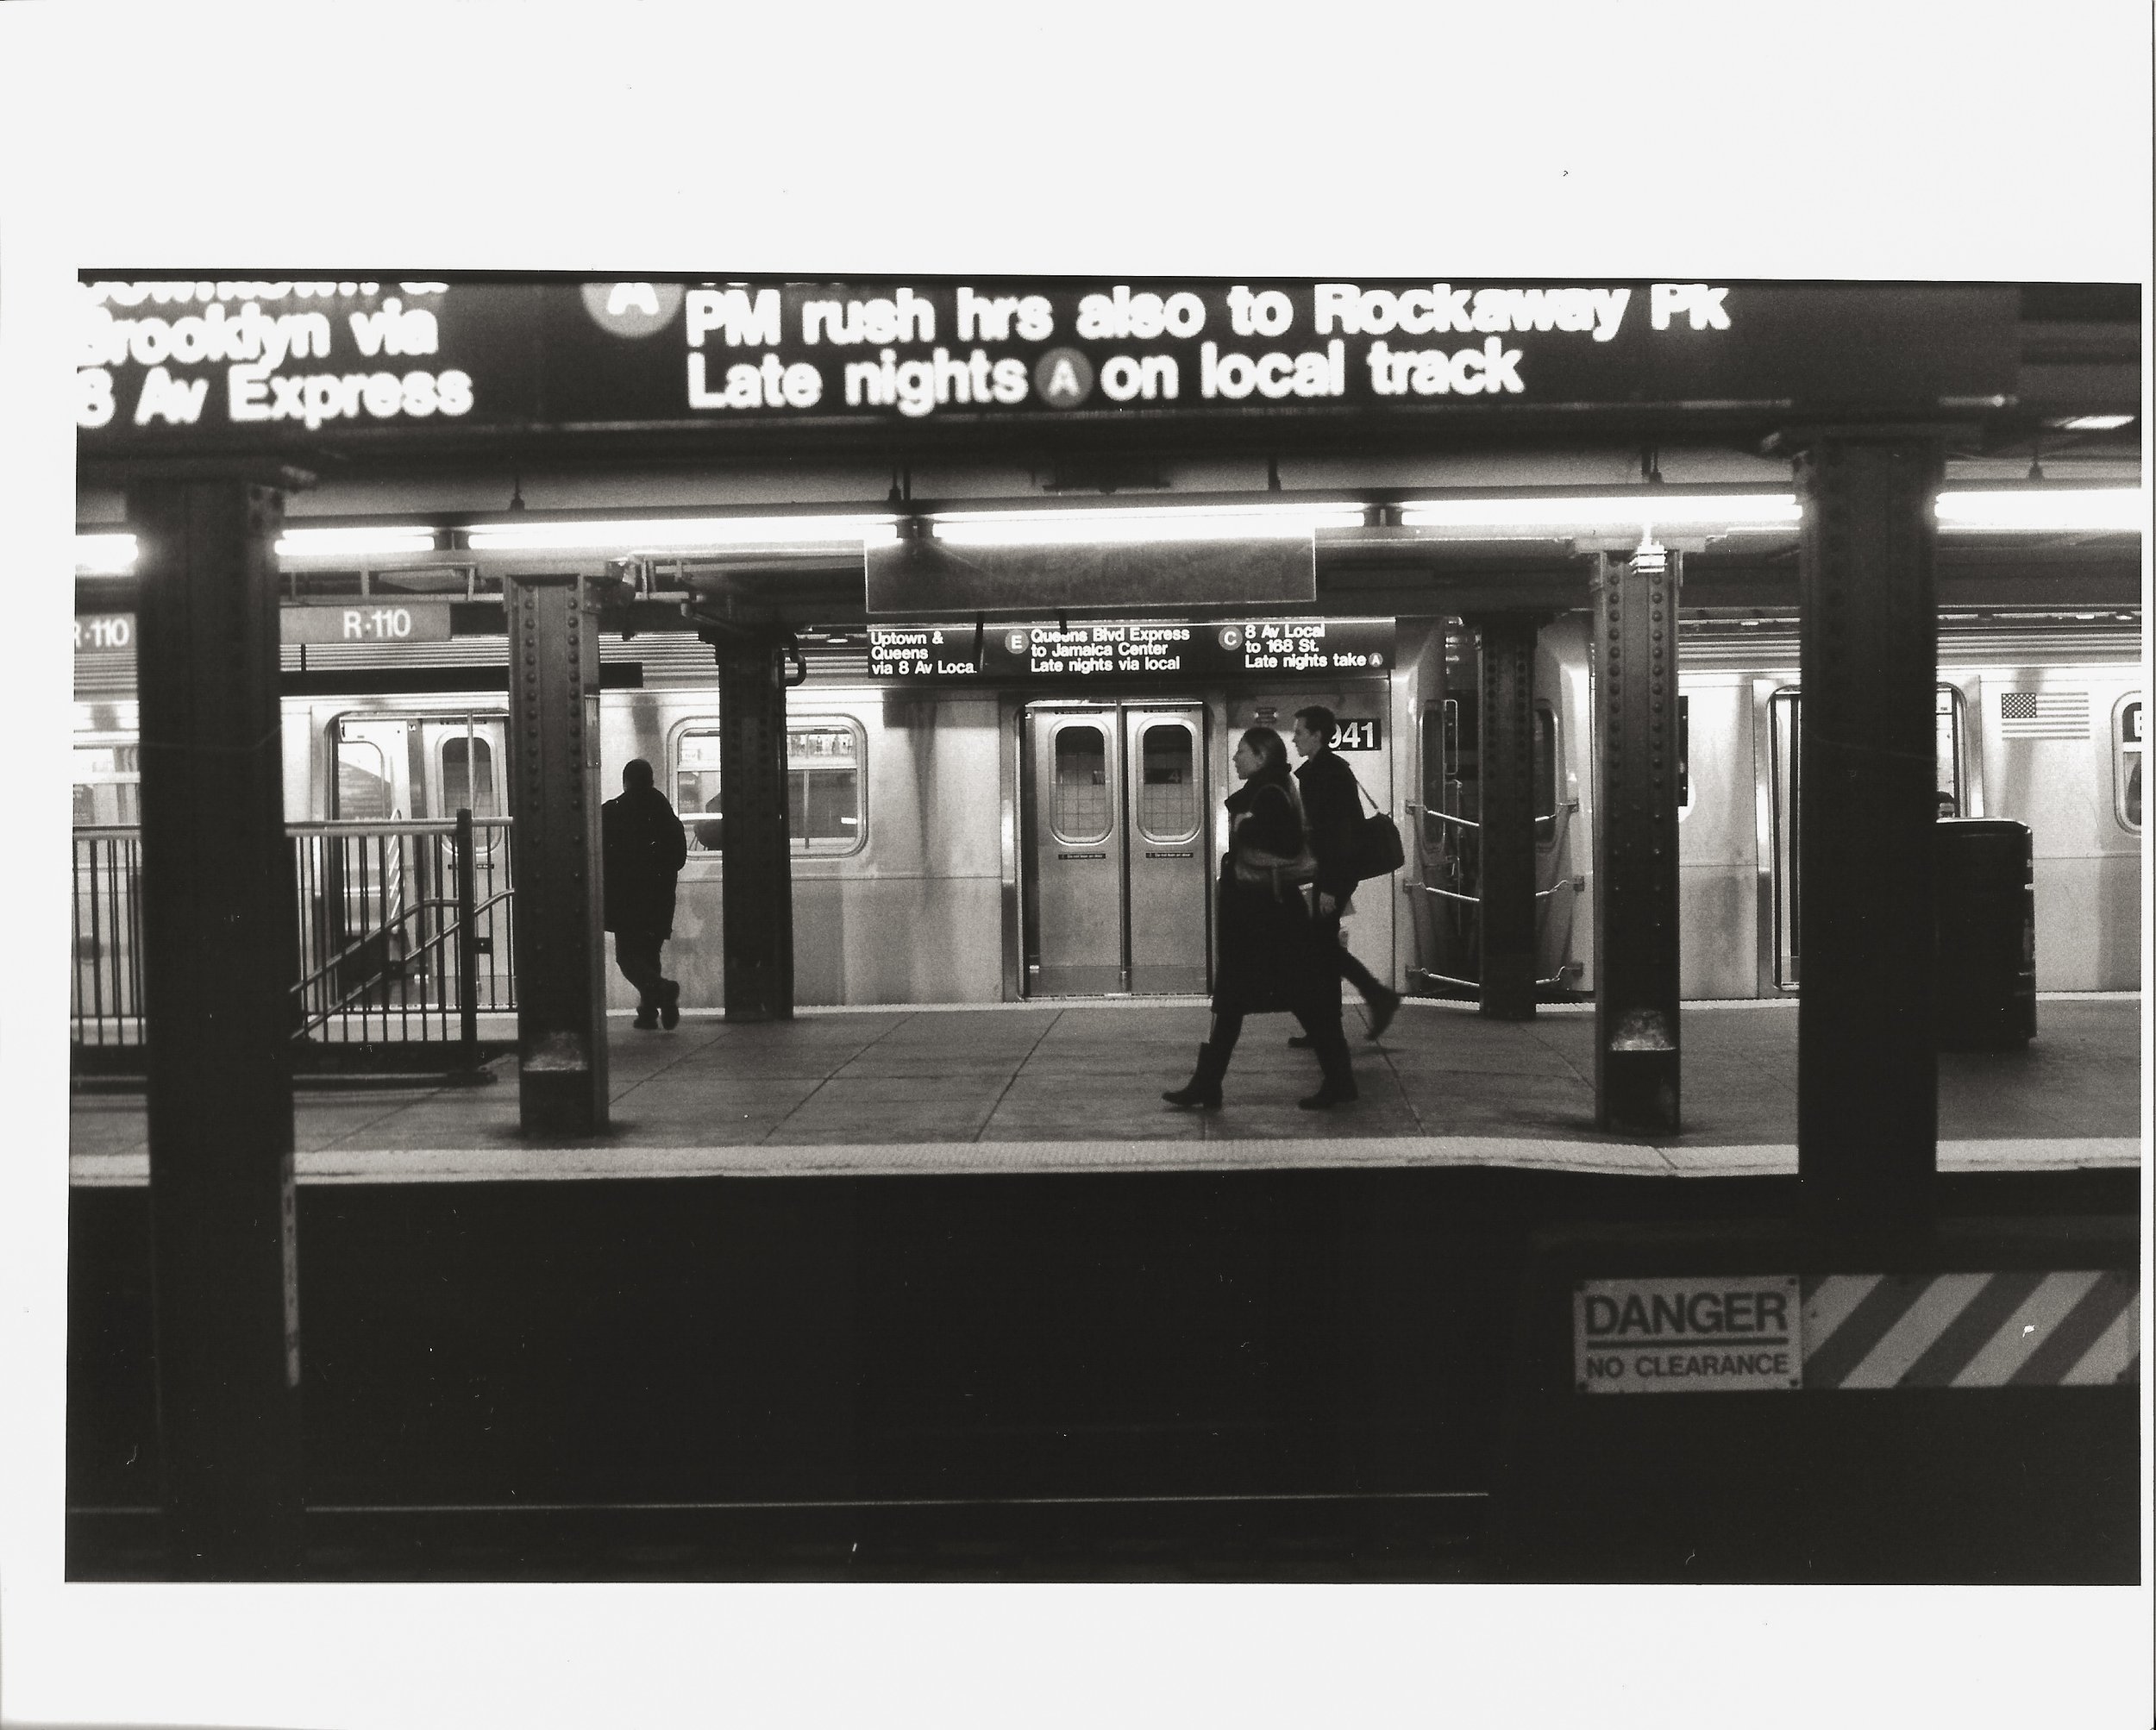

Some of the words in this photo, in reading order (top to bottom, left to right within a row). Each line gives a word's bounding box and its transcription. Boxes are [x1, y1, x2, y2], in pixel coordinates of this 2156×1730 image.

[686, 288, 781, 347] PM
[802, 286, 936, 346] rush
[957, 286, 1053, 342] hrs
[1076, 285, 1206, 340] also
[1226, 285, 1294, 337] to
[1314, 283, 1632, 342] Rockaway
[1651, 283, 1732, 331] Pk
[349, 297, 440, 356] via
[686, 351, 824, 409] Late
[845, 348, 1029, 417] nights
[1046, 355, 1081, 398] A
[1100, 354, 1179, 401] on
[1200, 338, 1345, 399] local
[1366, 335, 1525, 396] track
[76, 365, 115, 428] 8
[135, 366, 210, 426] Av
[227, 361, 474, 431] Express
[871, 631, 927, 648] Uptown
[931, 631, 944, 645] &
[1031, 629, 1089, 643] Queens
[1093, 627, 1125, 642] Blvd
[1130, 627, 1190, 644] Express
[1223, 631, 1238, 646] C
[1244, 624, 1257, 639] 8
[1261, 624, 1280, 639] Av
[1284, 624, 1326, 638] Local
[1011, 635, 1023, 649] E
[1031, 643, 1048, 658] to
[1051, 642, 1113, 657] Jamaica
[1118, 642, 1169, 655] Center
[1244, 640, 1262, 654] to
[1265, 639, 1294, 653] 168
[1298, 638, 1319, 653] St.
[871, 647, 929, 661] Queens
[1244, 655, 1278, 668] Late
[1282, 654, 1328, 671] nights
[1332, 652, 1368, 667] take
[871, 661, 893, 675] via
[898, 661, 910, 675] 8
[914, 661, 933, 674] Av
[937, 660, 978, 674] Loca
[1031, 658, 1064, 673] Late
[1069, 657, 1113, 674] nights
[1118, 656, 1140, 671] via
[1144, 655, 1181, 670] local
[1587, 1292, 1789, 1335] DANGER
[1587, 1356, 1625, 1378] NO
[1636, 1354, 1789, 1377] CLEARANCE
